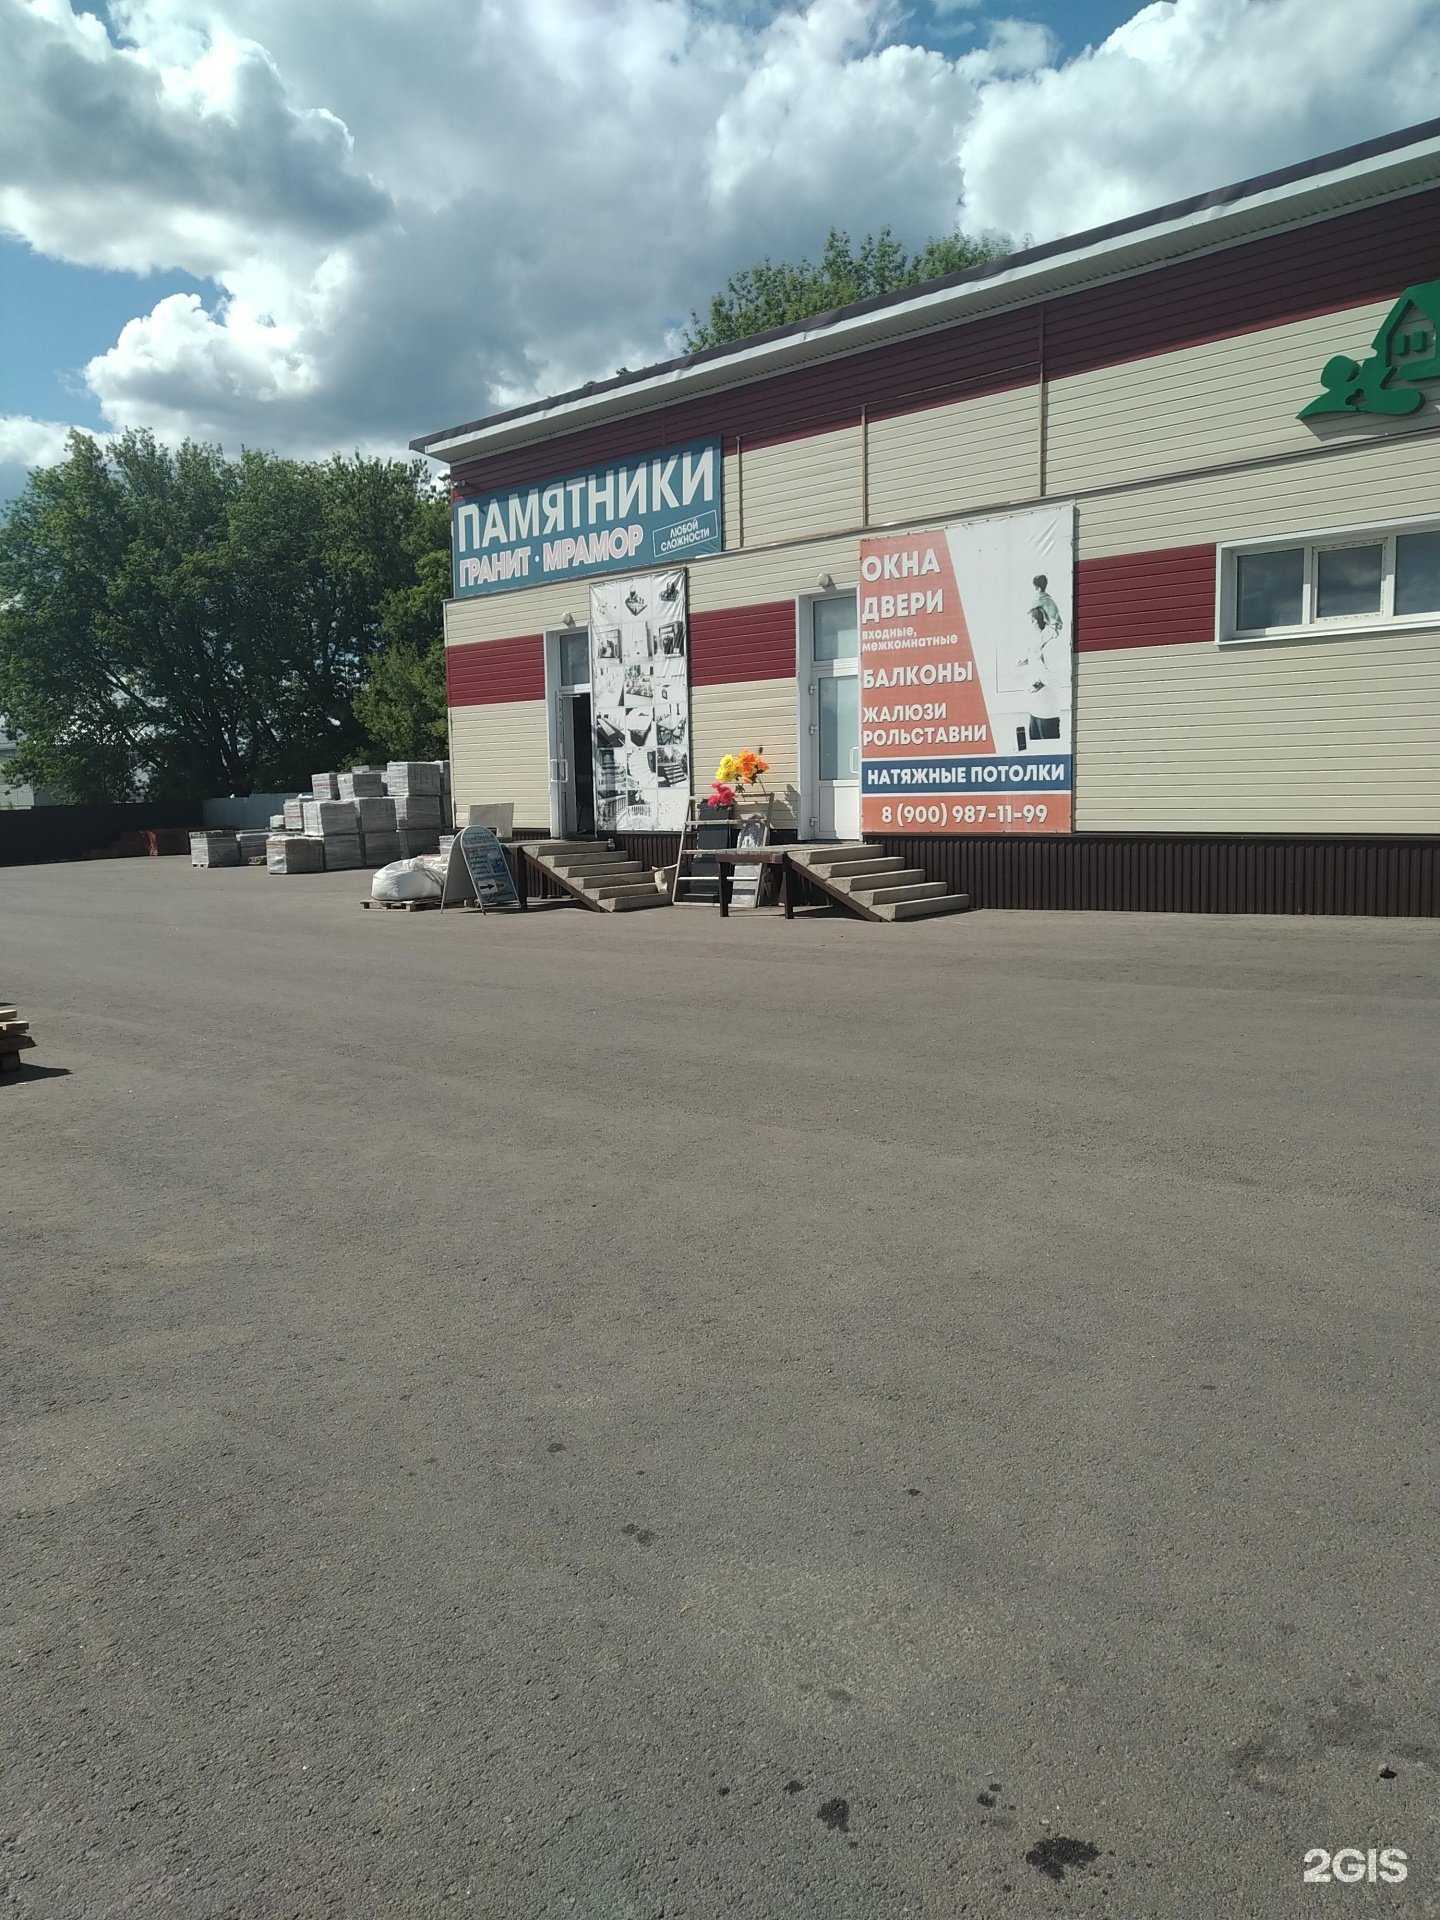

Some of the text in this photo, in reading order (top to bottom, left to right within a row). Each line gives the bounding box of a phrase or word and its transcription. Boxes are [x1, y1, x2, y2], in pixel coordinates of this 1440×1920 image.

[458, 446, 714, 553] ПАМЯТНИКИ
[669, 519, 699, 538] ЛЮБОЙ
[660, 529, 710, 553] СЛОЖНОСТИ
[459, 525, 644, 588] ГРАНИТ МРАМОР
[861, 549, 941, 582] ОКНА
[861, 588, 944, 624] ДВЕРИ
[861, 626, 917, 640] входные,
[861, 634, 958, 652] межкомнатные
[862, 661, 973, 689] БАЛКОНЫ
[862, 702, 947, 723] ЖАЛЮЗИ
[862, 724, 987, 747] РОЛЬСТАВНИ
[867, 763, 1065, 785] НАТЯЖНЫЕ ПОТОЛКИ
[881, 802, 1047, 826] 8 (900) 987-11-99
